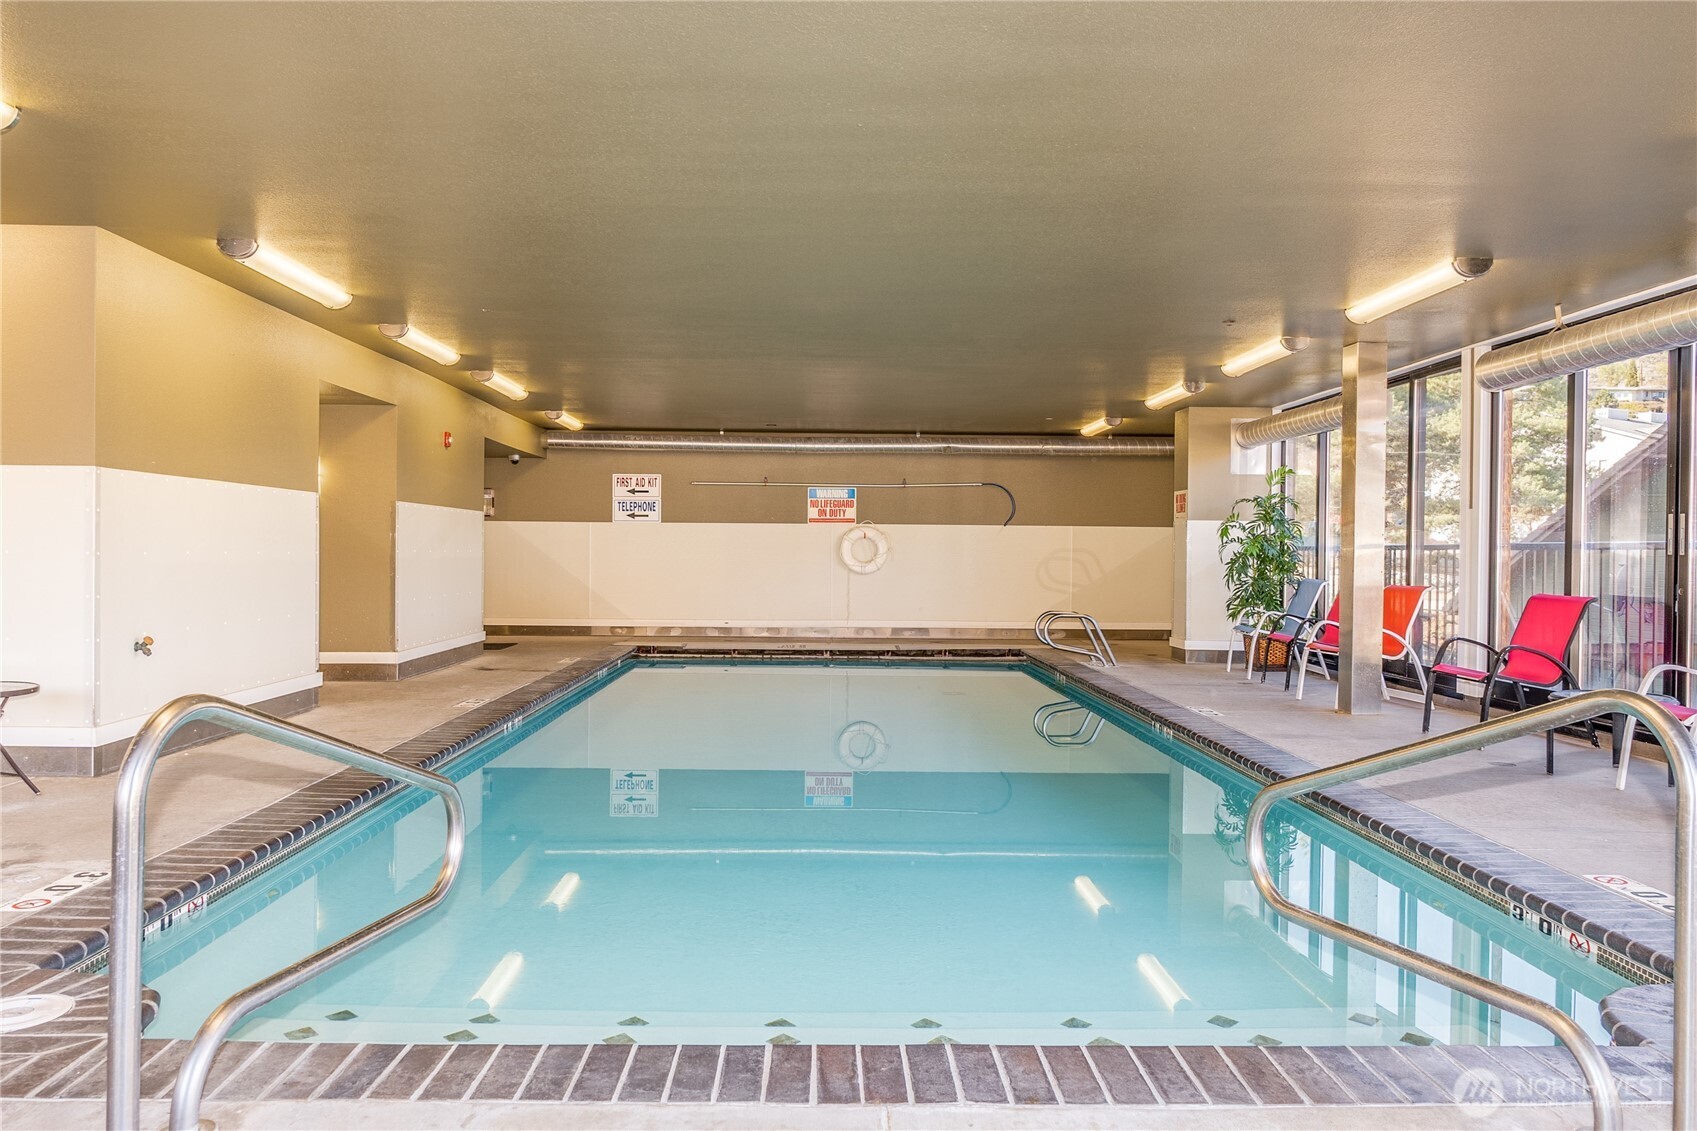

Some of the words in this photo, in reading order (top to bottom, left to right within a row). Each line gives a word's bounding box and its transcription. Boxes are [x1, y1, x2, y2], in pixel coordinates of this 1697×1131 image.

[616, 477, 633, 488] FIRST
[635, 477, 646, 488] AID
[648, 477, 658, 488] KIT
[617, 501, 656, 512] TELEPHONE
[810, 499, 820, 509] NO
[820, 499, 855, 509] LIFEGUARD
[817, 509, 828, 518] ON
[829, 509, 847, 518] DUTY
[1512, 903, 1525, 921] 3
